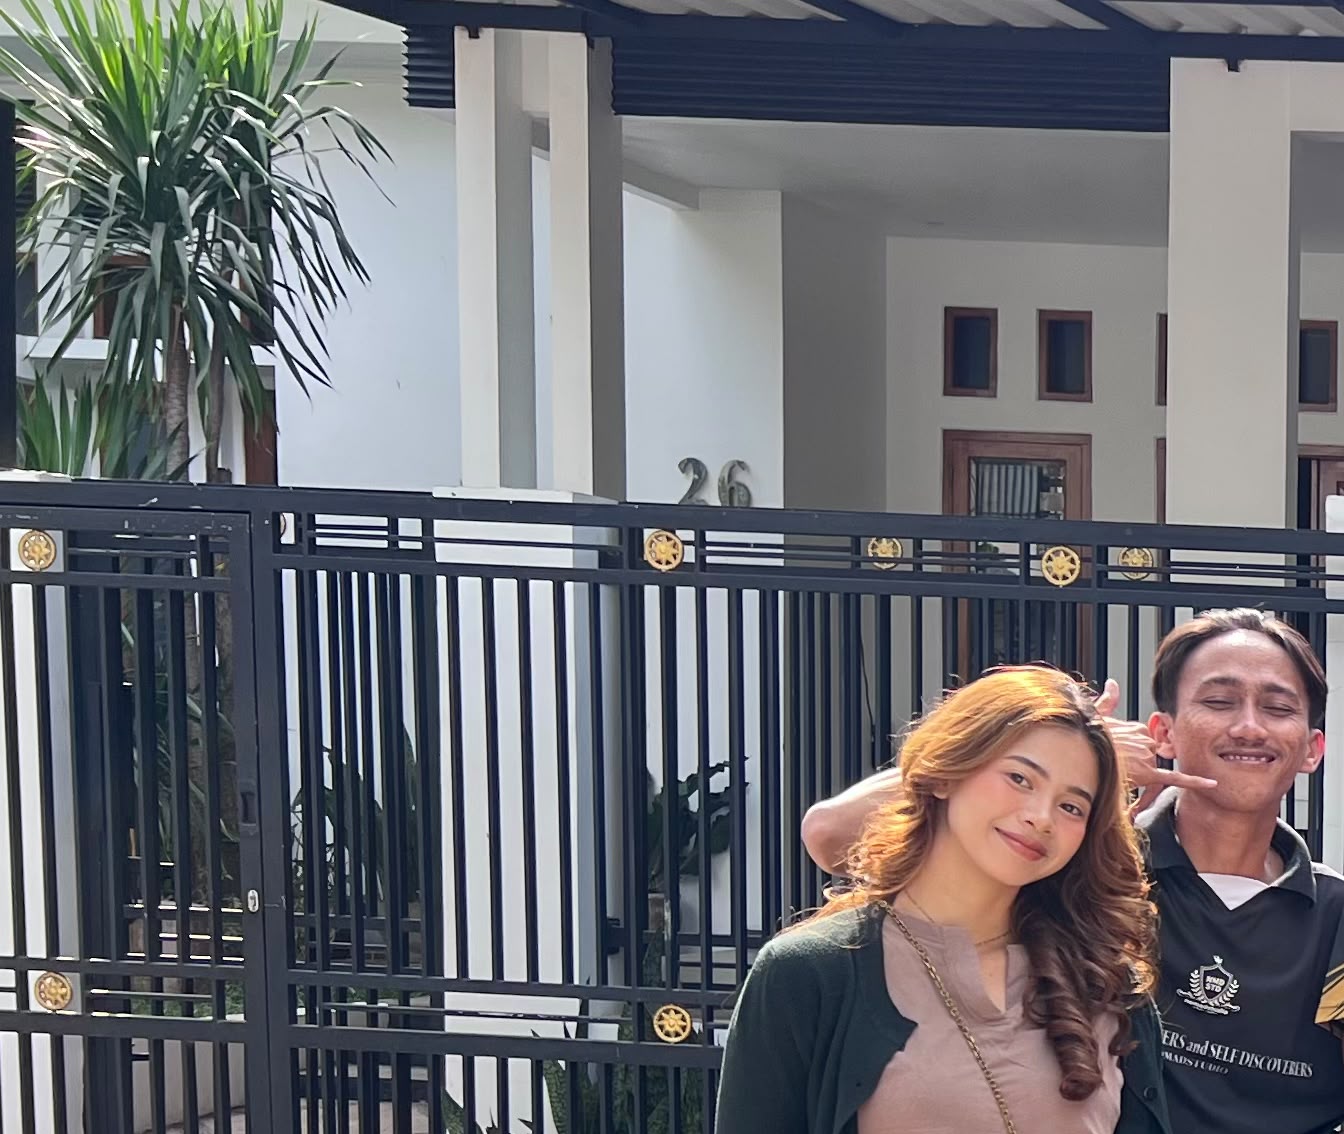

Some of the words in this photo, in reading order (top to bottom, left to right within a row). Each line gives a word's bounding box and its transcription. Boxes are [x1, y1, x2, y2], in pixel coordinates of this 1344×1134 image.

[677, 457, 753, 507] 26
[1185, 1040, 1210, 1057] and
[1210, 1043, 1240, 1064] SELF
